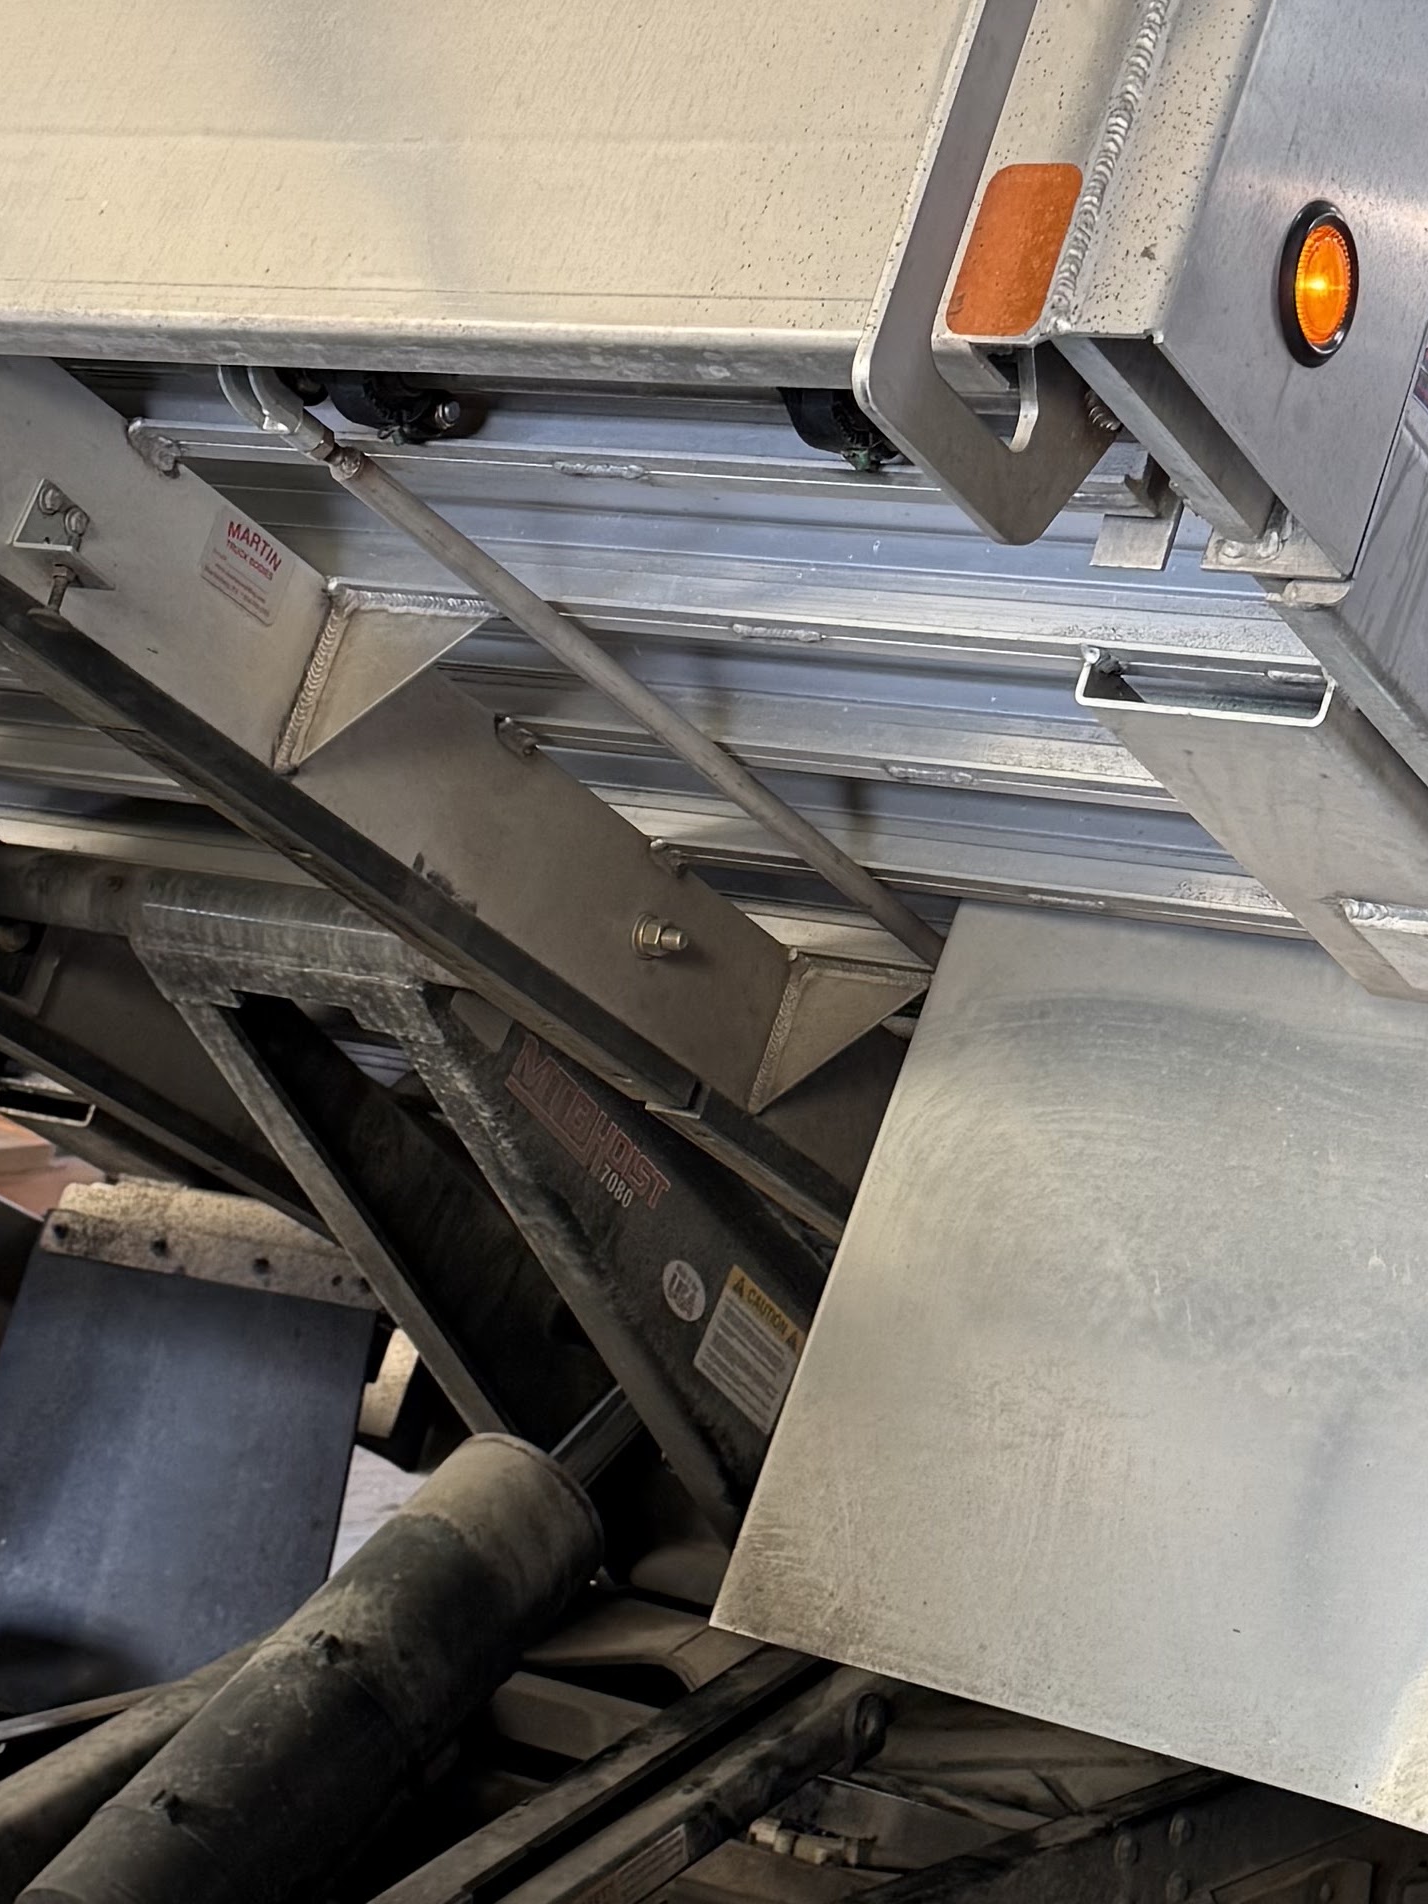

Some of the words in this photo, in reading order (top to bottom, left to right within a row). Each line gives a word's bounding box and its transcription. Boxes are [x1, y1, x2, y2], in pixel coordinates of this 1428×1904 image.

[227, 521, 282, 572] MARTIN
[227, 539, 248, 560] TRUCK
[599, 1163, 634, 1208] 7080
[747, 1289, 789, 1337] CAUTION
